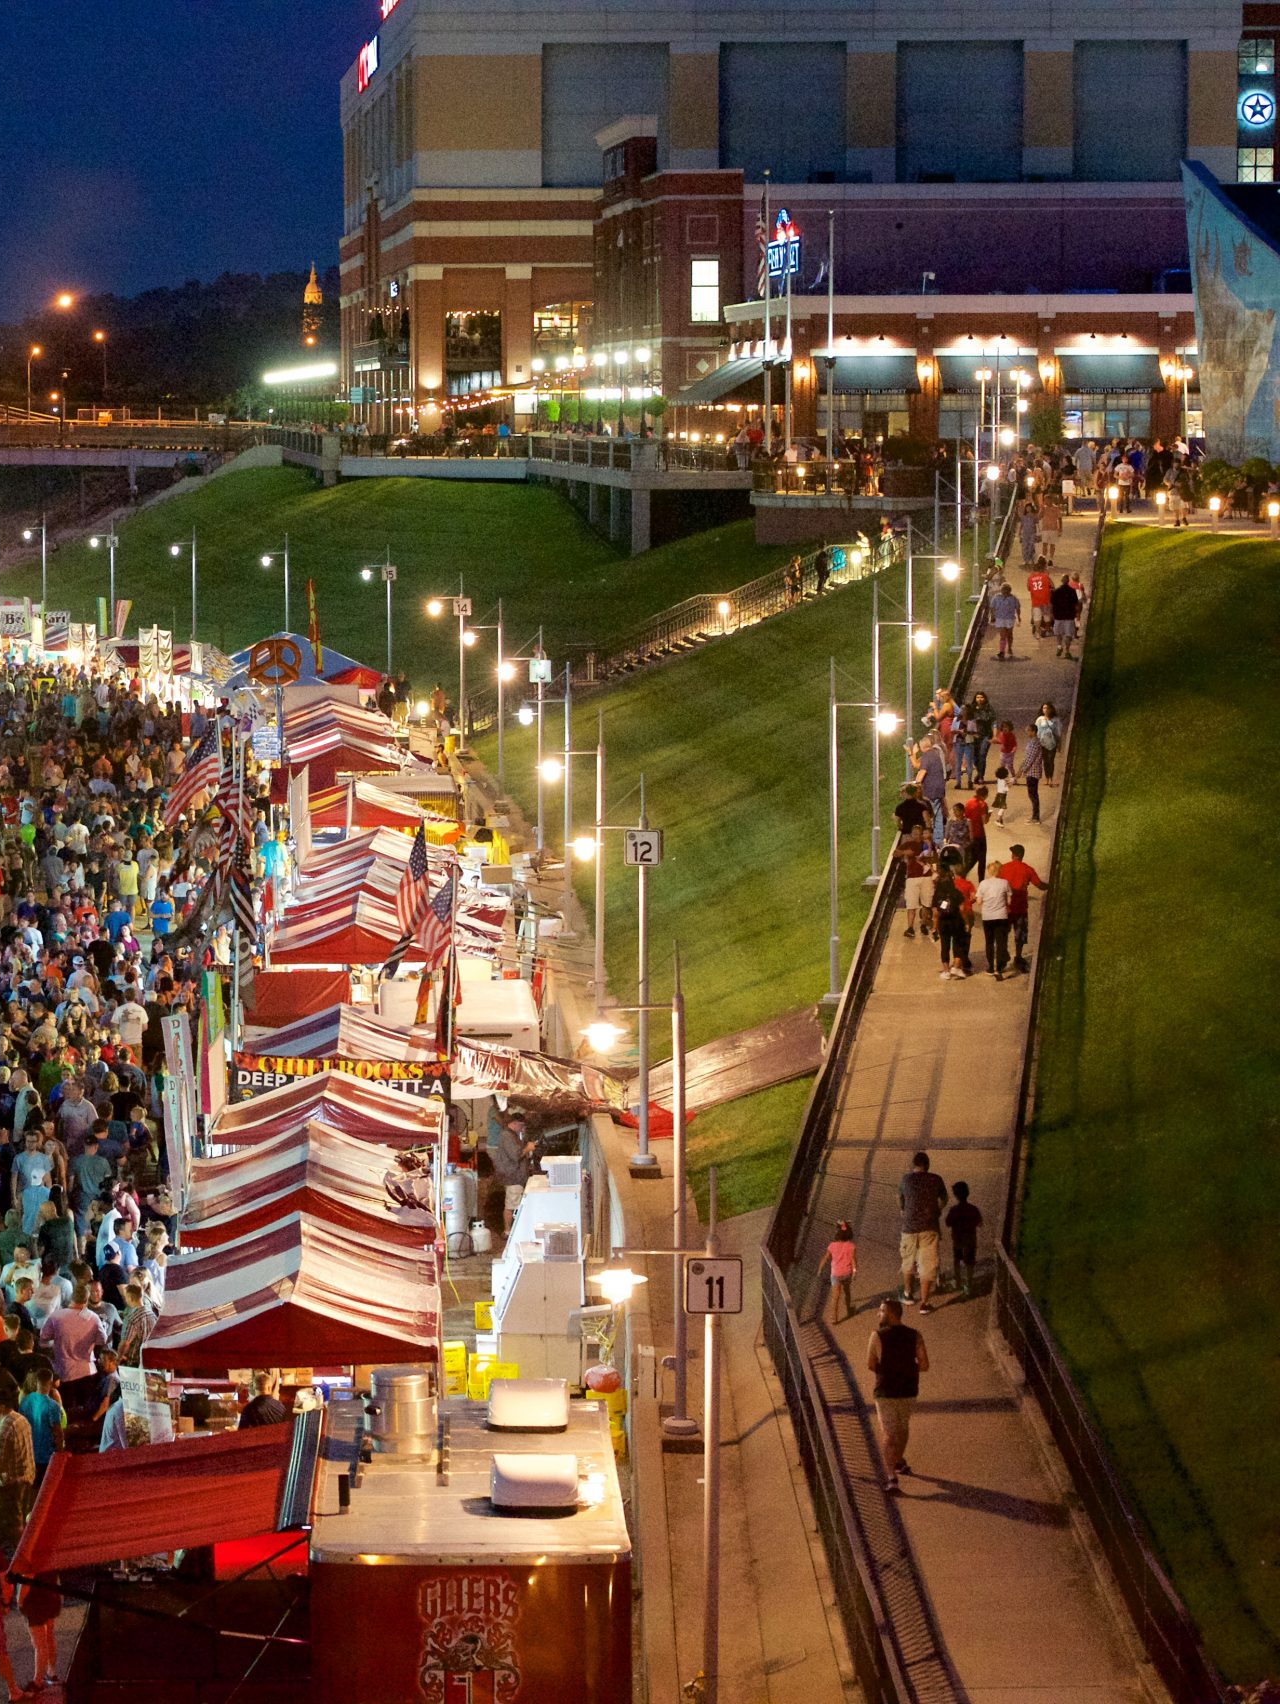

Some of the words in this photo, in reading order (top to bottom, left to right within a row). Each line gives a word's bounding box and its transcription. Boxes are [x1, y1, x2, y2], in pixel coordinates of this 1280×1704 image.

[386, 571, 394, 579] 15
[1032, 581, 1043, 591] 32
[457, 604, 468, 614] 14
[632, 841, 652, 862] 12
[237, 1071, 288, 1087] DEEP
[705, 1276, 724, 1309] 11
[419, 1577, 520, 1623] GLIER'S
